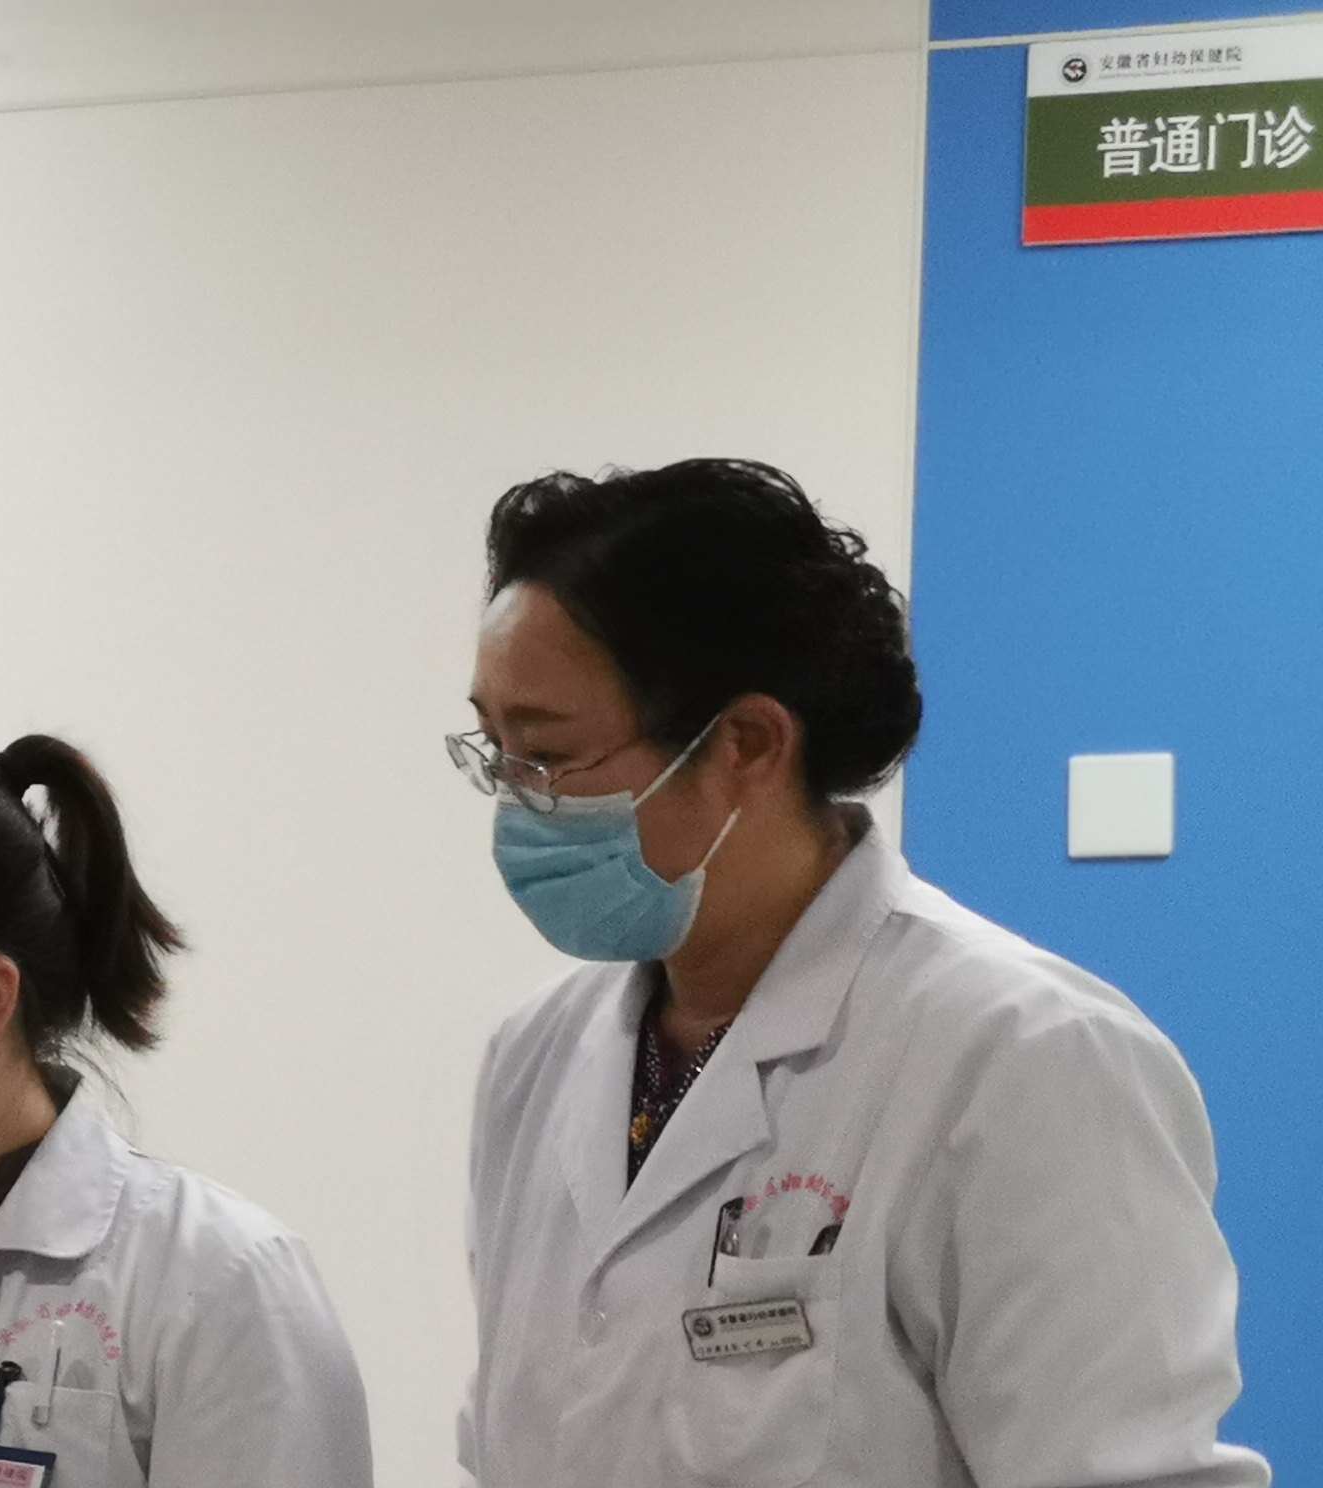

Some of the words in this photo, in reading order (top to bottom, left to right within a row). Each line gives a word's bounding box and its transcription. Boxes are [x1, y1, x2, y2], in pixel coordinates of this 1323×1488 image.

[1100, 46, 1243, 70] 安徽省妇幼保健院
[1096, 105, 1315, 178] 普通门诊
